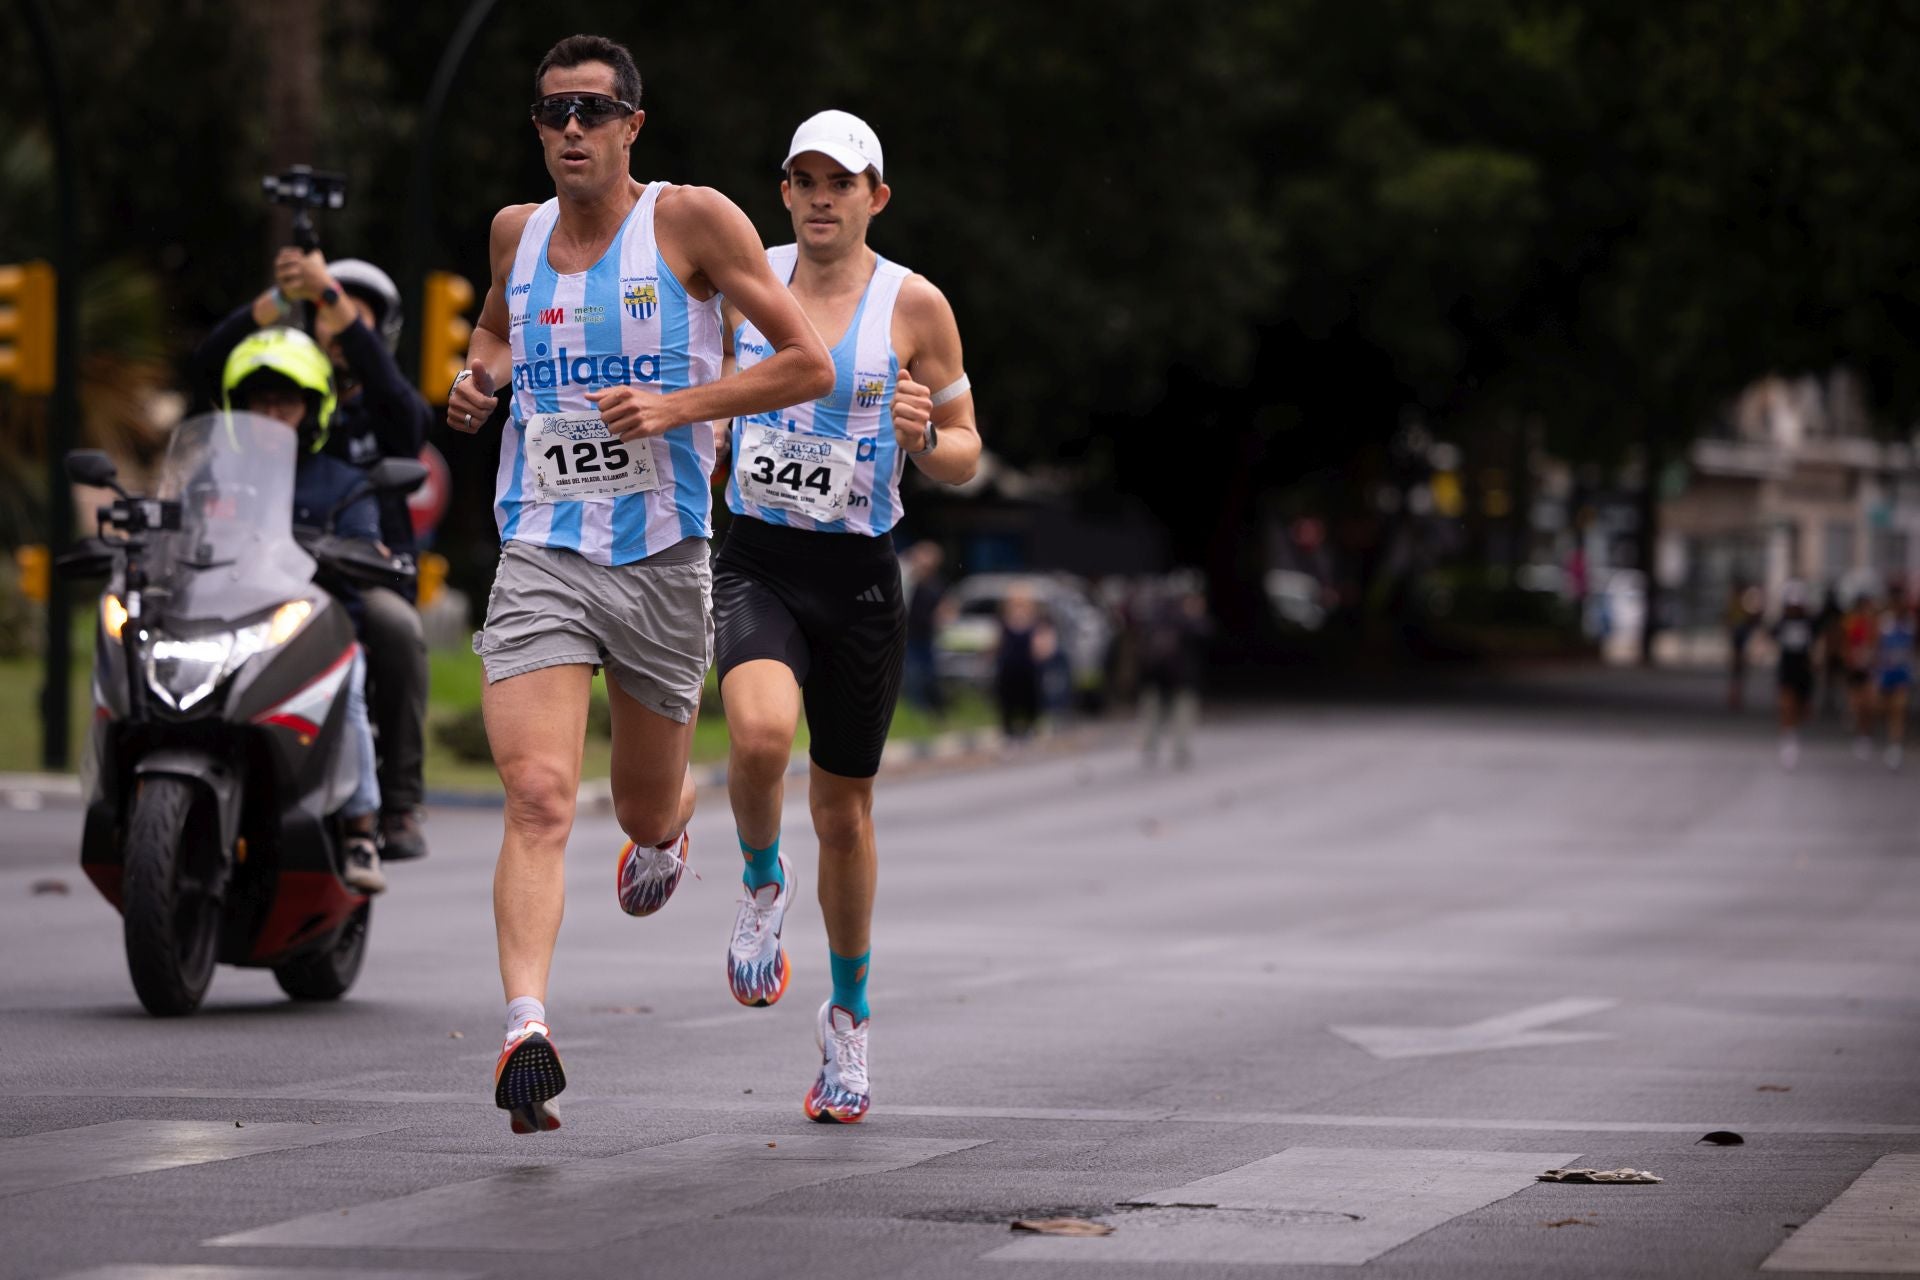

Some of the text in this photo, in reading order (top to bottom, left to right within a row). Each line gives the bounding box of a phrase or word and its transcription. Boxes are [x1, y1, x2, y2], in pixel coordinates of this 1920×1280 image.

[511, 283, 531, 296] vive
[574, 306, 604, 314] metro
[544, 439, 629, 475] 125
[751, 456, 831, 496] 344
